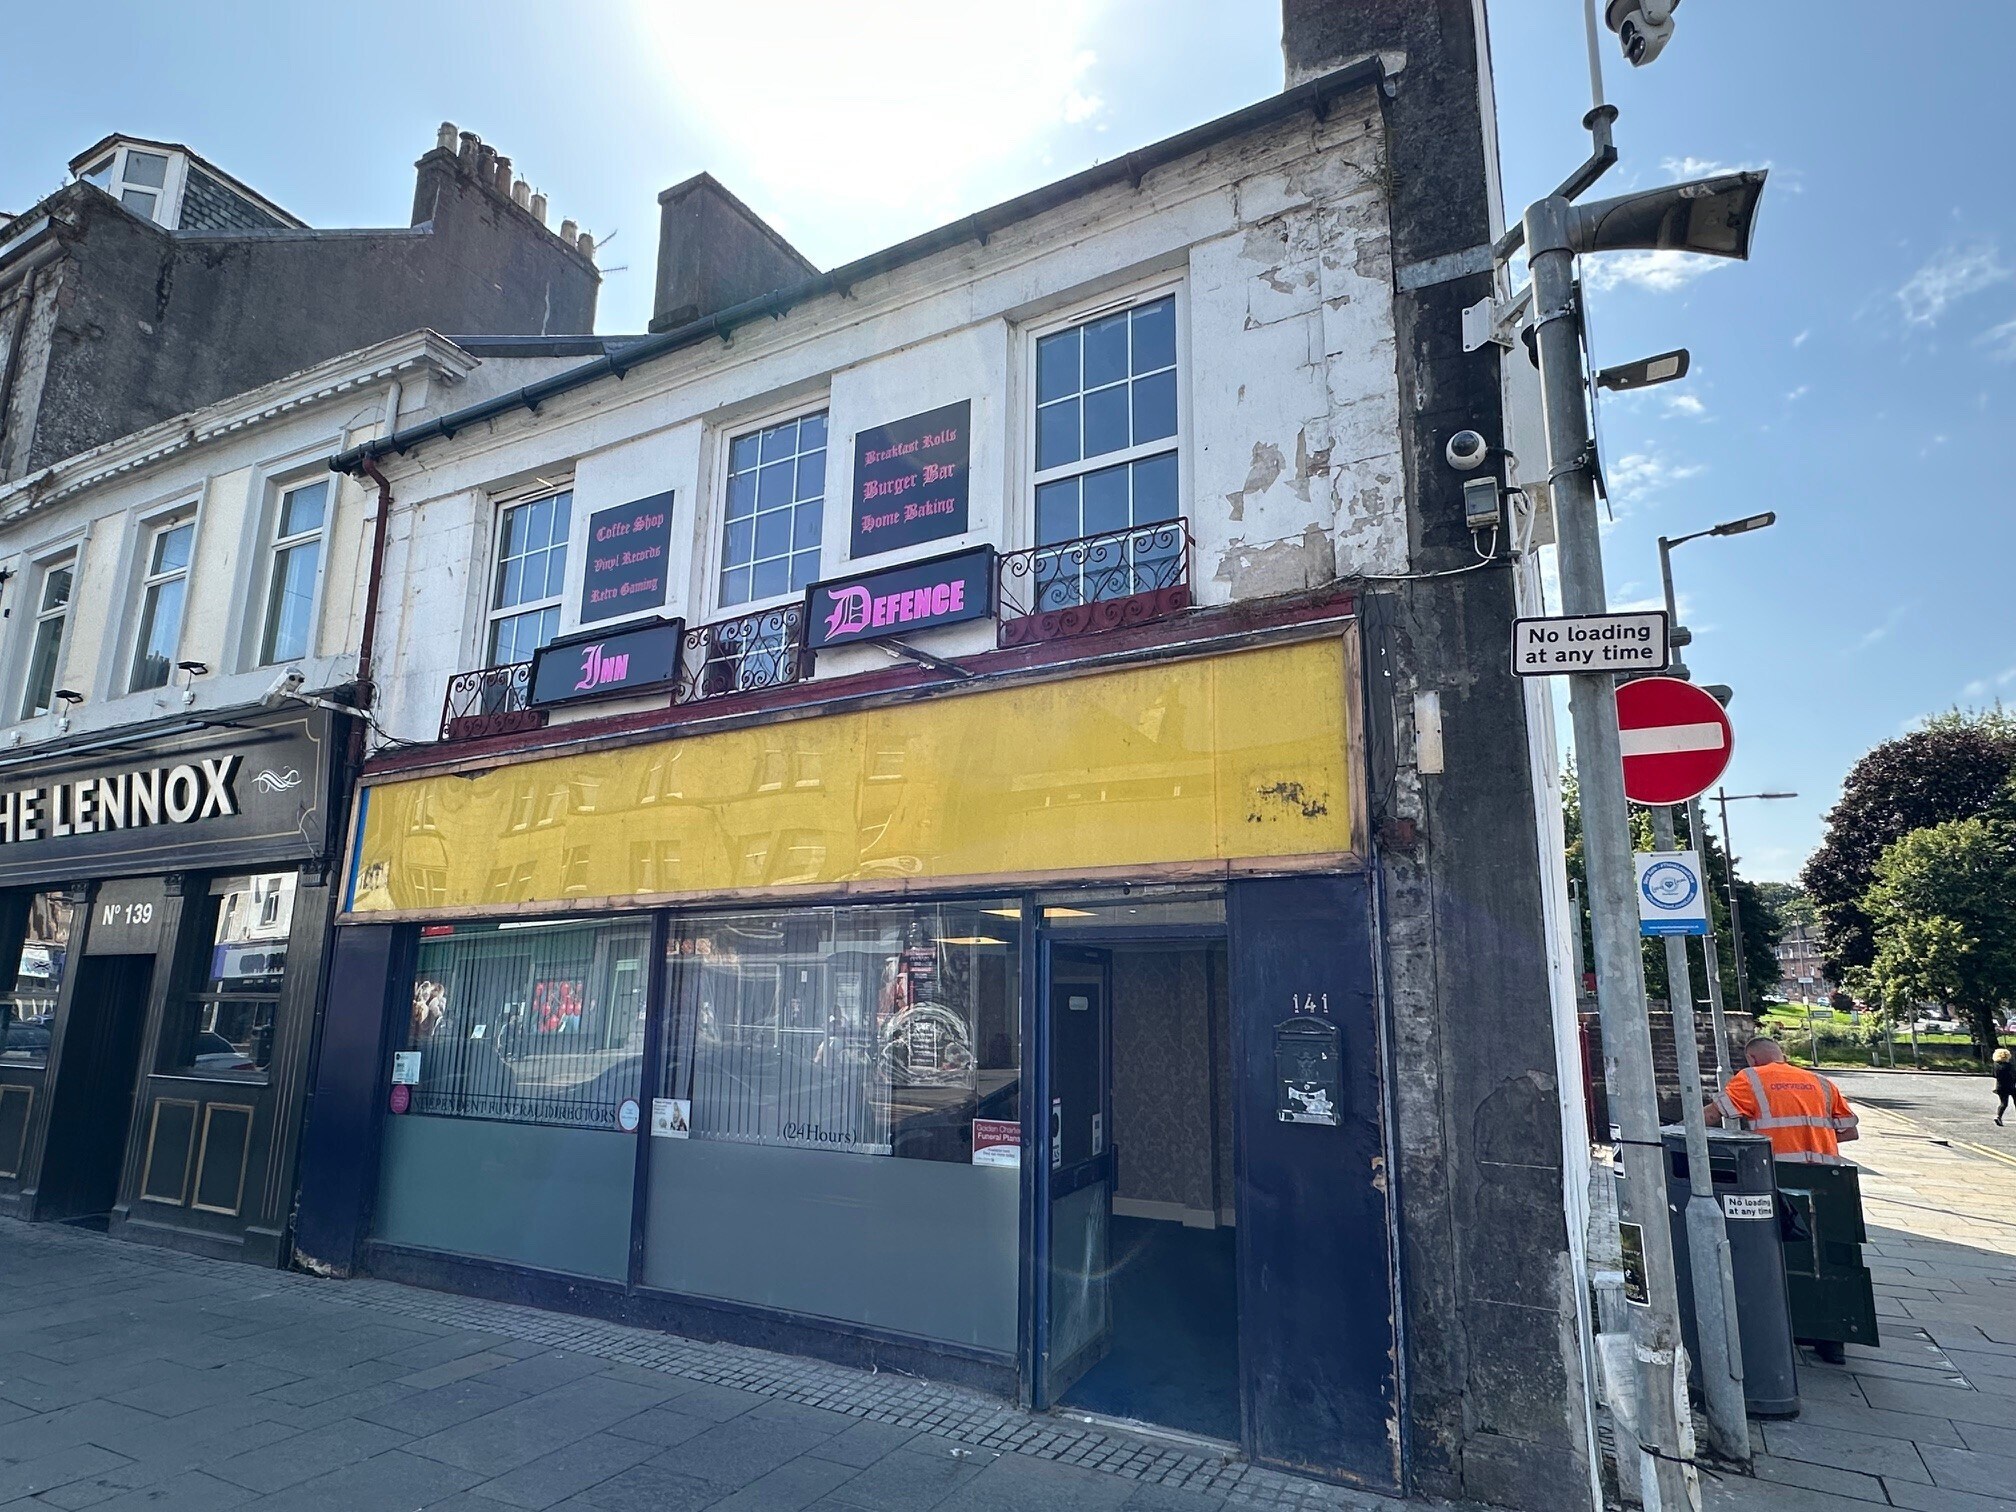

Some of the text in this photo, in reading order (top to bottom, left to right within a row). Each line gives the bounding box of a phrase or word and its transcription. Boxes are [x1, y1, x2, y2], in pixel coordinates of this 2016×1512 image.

[864, 428, 958, 467] Breakfast Rolls
[862, 463, 956, 503] Burger Bar
[861, 498, 955, 534] Home Baking
[596, 513, 664, 542] Coffee Shop
[594, 546, 661, 572] Vinyl Records
[590, 578, 658, 603] Retro Gaming
[1529, 624, 1650, 643] No loading
[1525, 644, 1653, 665] at any time
[0, 755, 238, 843] HE LENNOX
[124, 902, 153, 925] 139
[1292, 992, 1329, 1014] 141
[1770, 1082, 1816, 1092] openreach
[411, 1095, 487, 1114] NDEPENDENT
[977, 1123, 1021, 1135] Golden Charte
[978, 1132, 1002, 1141] Funeral
[1729, 1198, 1771, 1207] No loading
[1741, 1209, 1756, 1217] any
